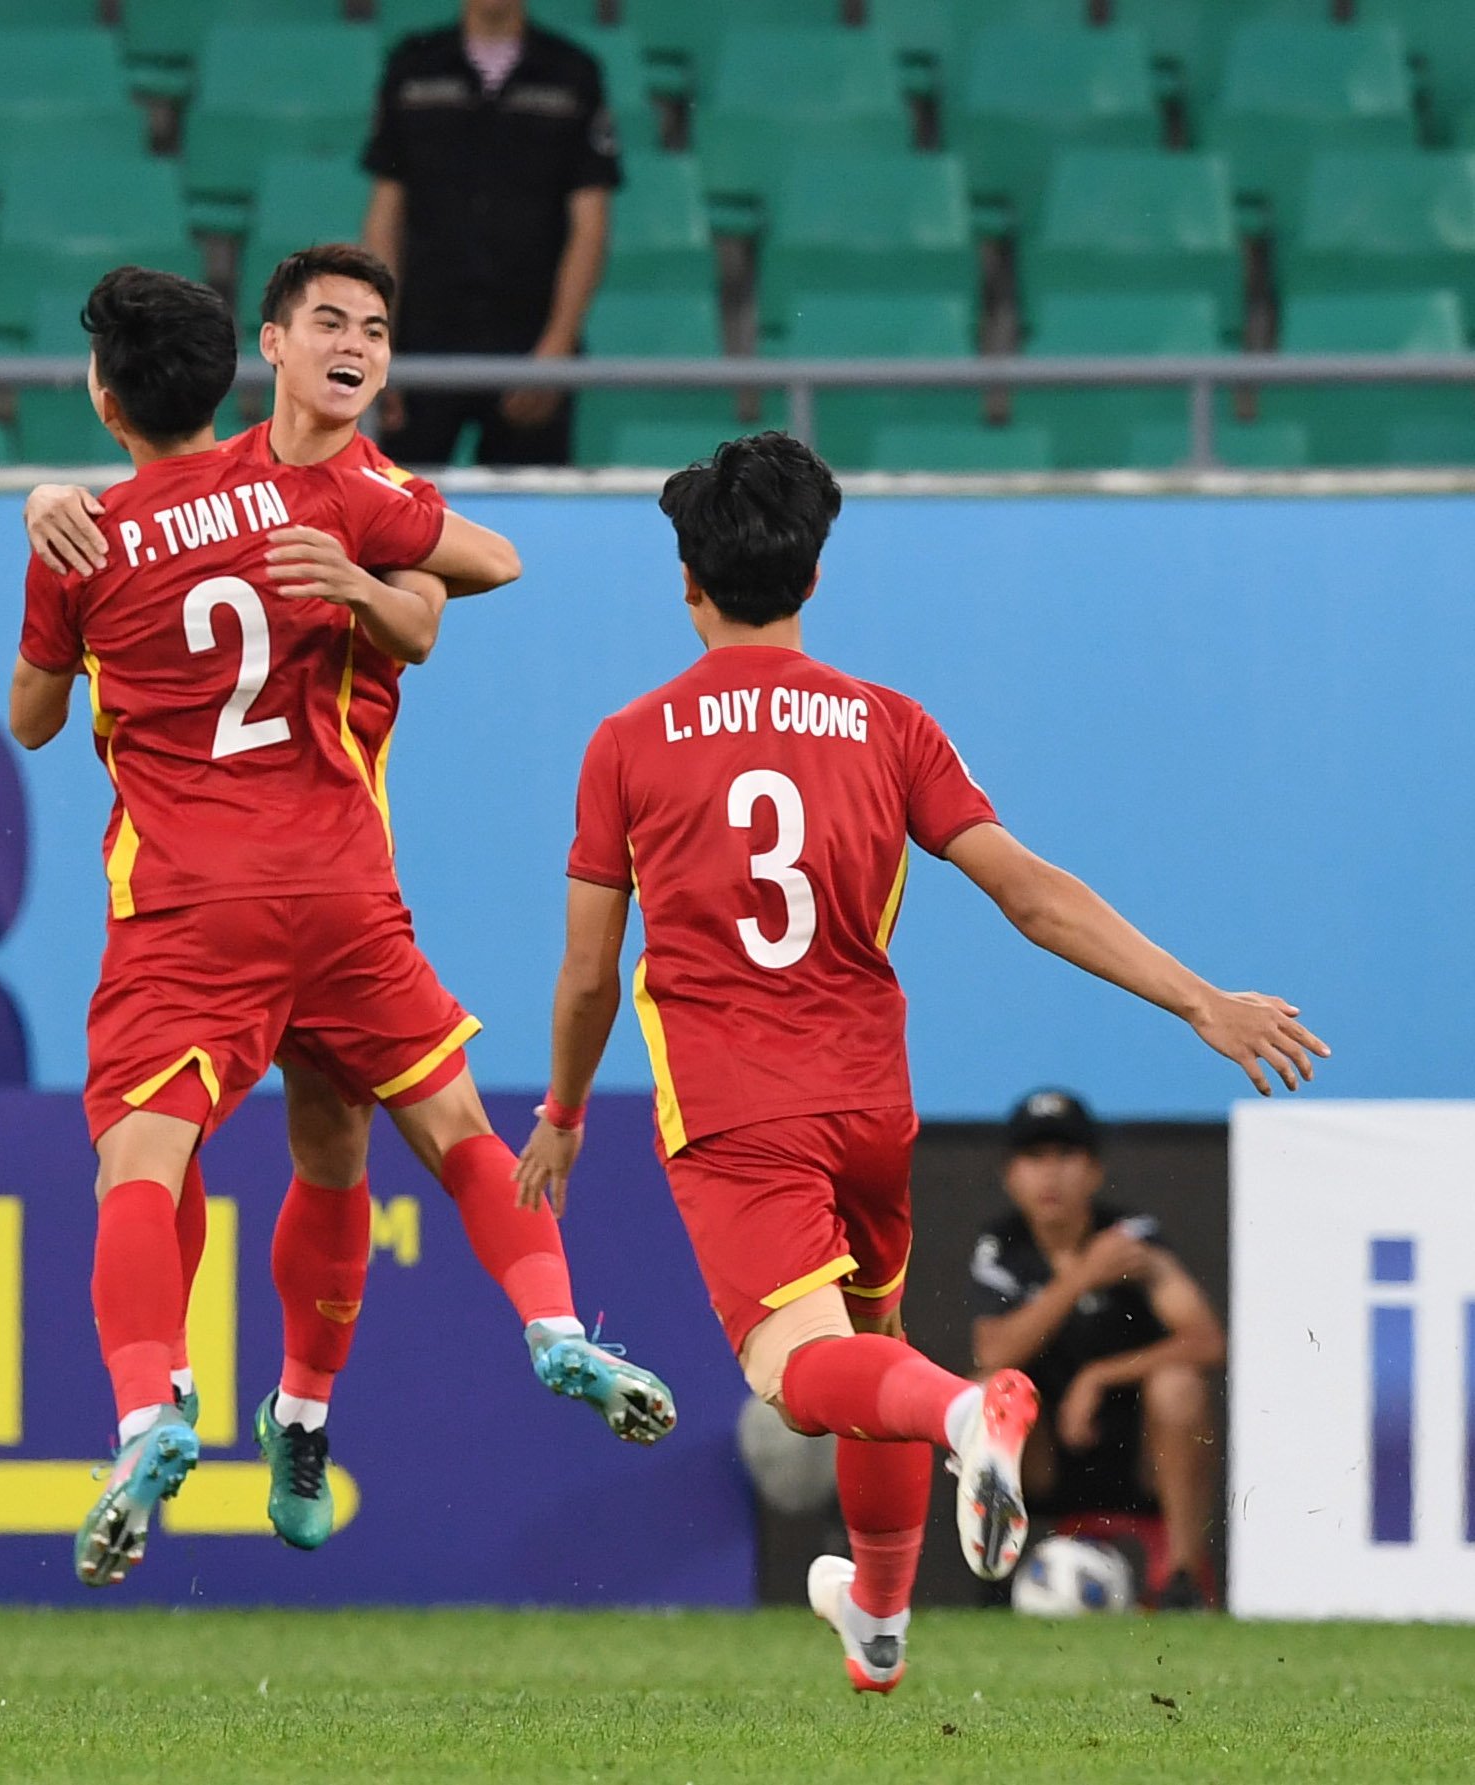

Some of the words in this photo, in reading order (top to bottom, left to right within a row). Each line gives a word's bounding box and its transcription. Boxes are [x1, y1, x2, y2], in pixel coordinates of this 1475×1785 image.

[119, 520, 157, 568] P.
[153, 491, 239, 555] TUAN
[234, 480, 290, 533] TAI
[182, 576, 291, 760] 2
[663, 702, 693, 743] L.
[698, 687, 761, 737] DUY
[770, 686, 869, 744] CUONG
[727, 769, 817, 969] 3
